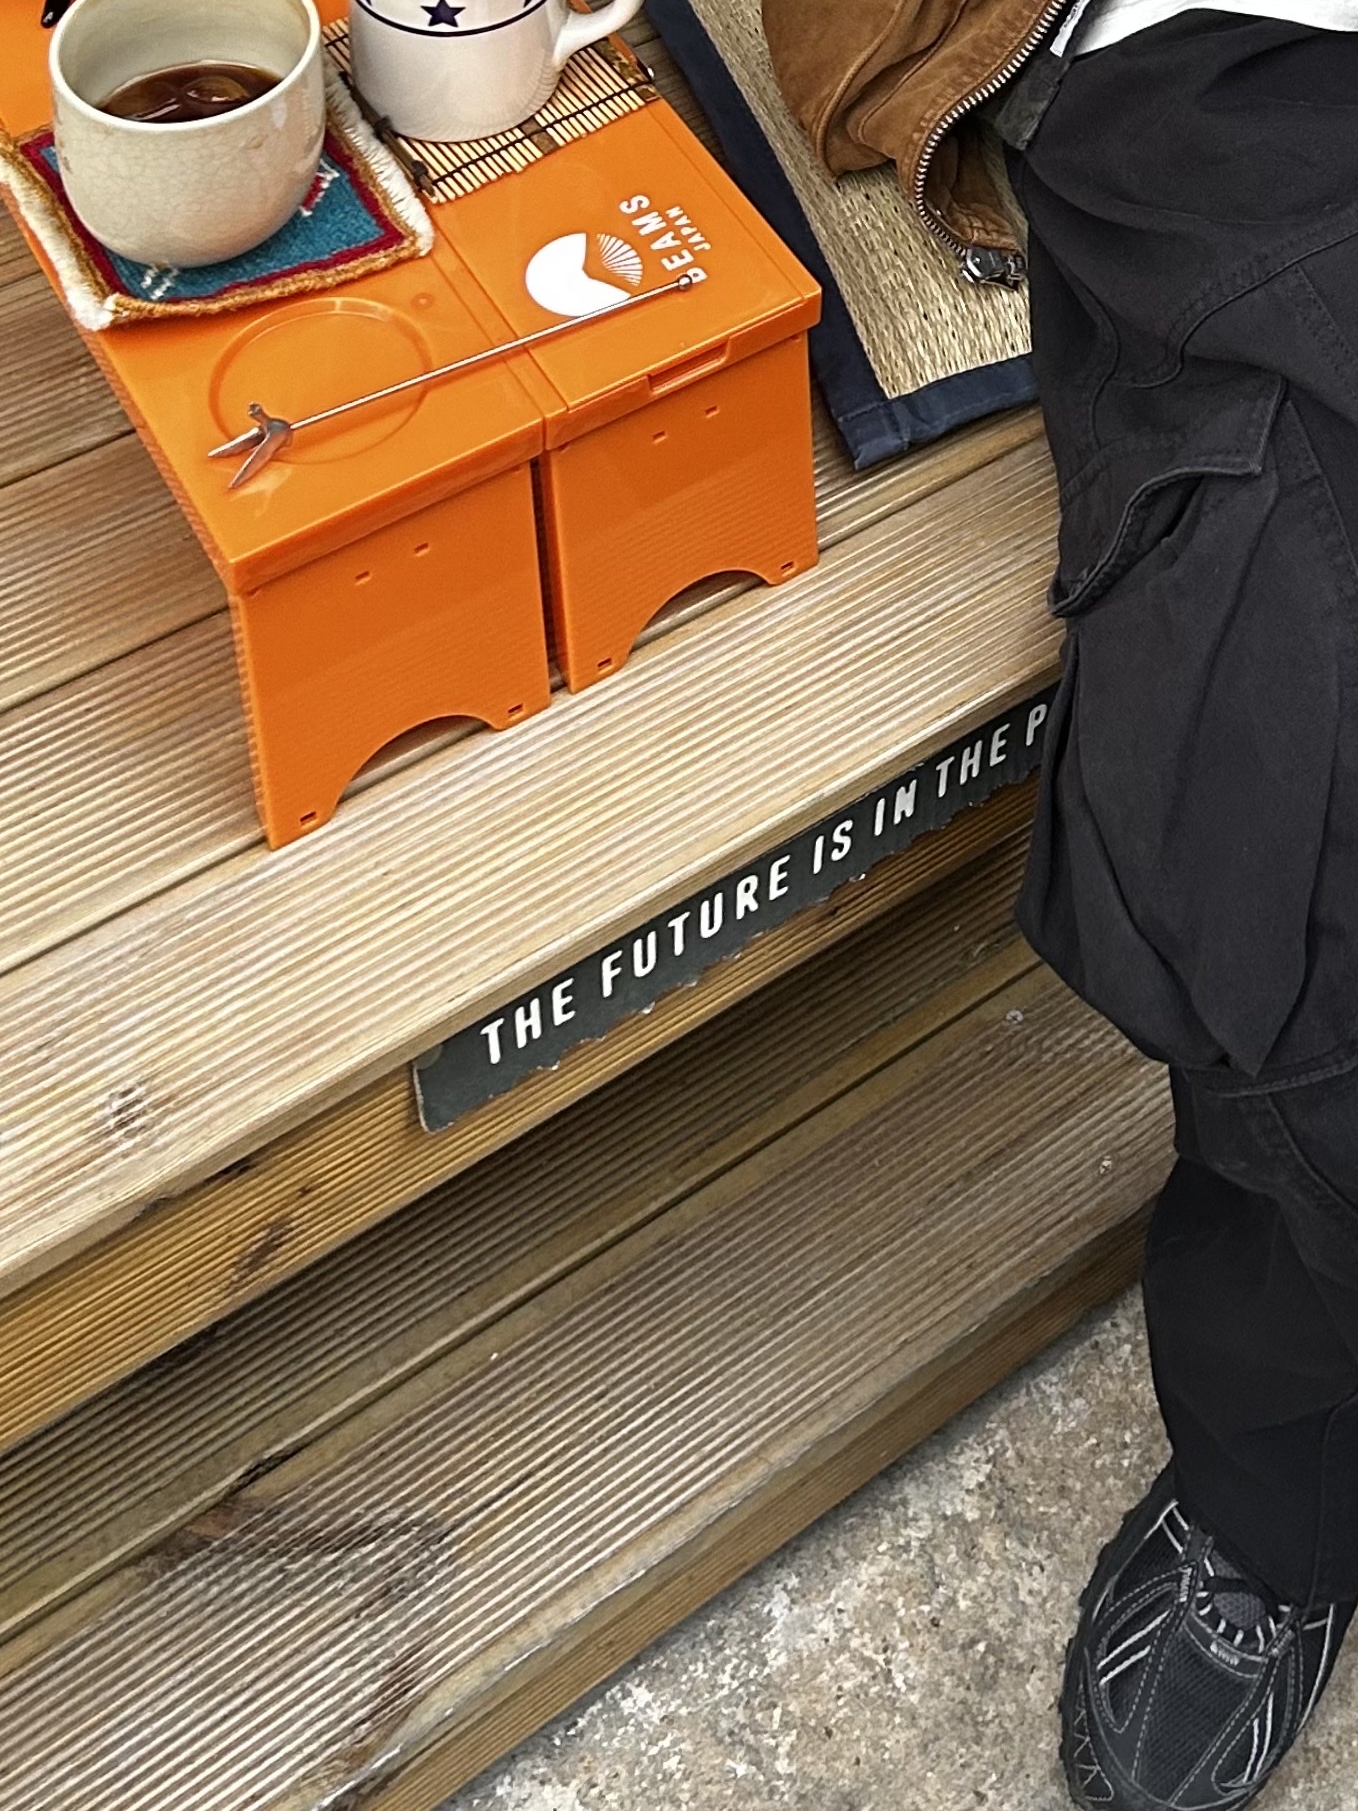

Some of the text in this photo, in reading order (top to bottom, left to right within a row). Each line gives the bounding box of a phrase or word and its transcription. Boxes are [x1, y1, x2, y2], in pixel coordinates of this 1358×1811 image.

[665, 206, 711, 251] JAPAN
[480, 978, 576, 1064] THE
[601, 854, 790, 998] FUTURE
[813, 819, 853, 874] IS
[874, 779, 917, 836] IN
[935, 723, 1010, 797] THE
